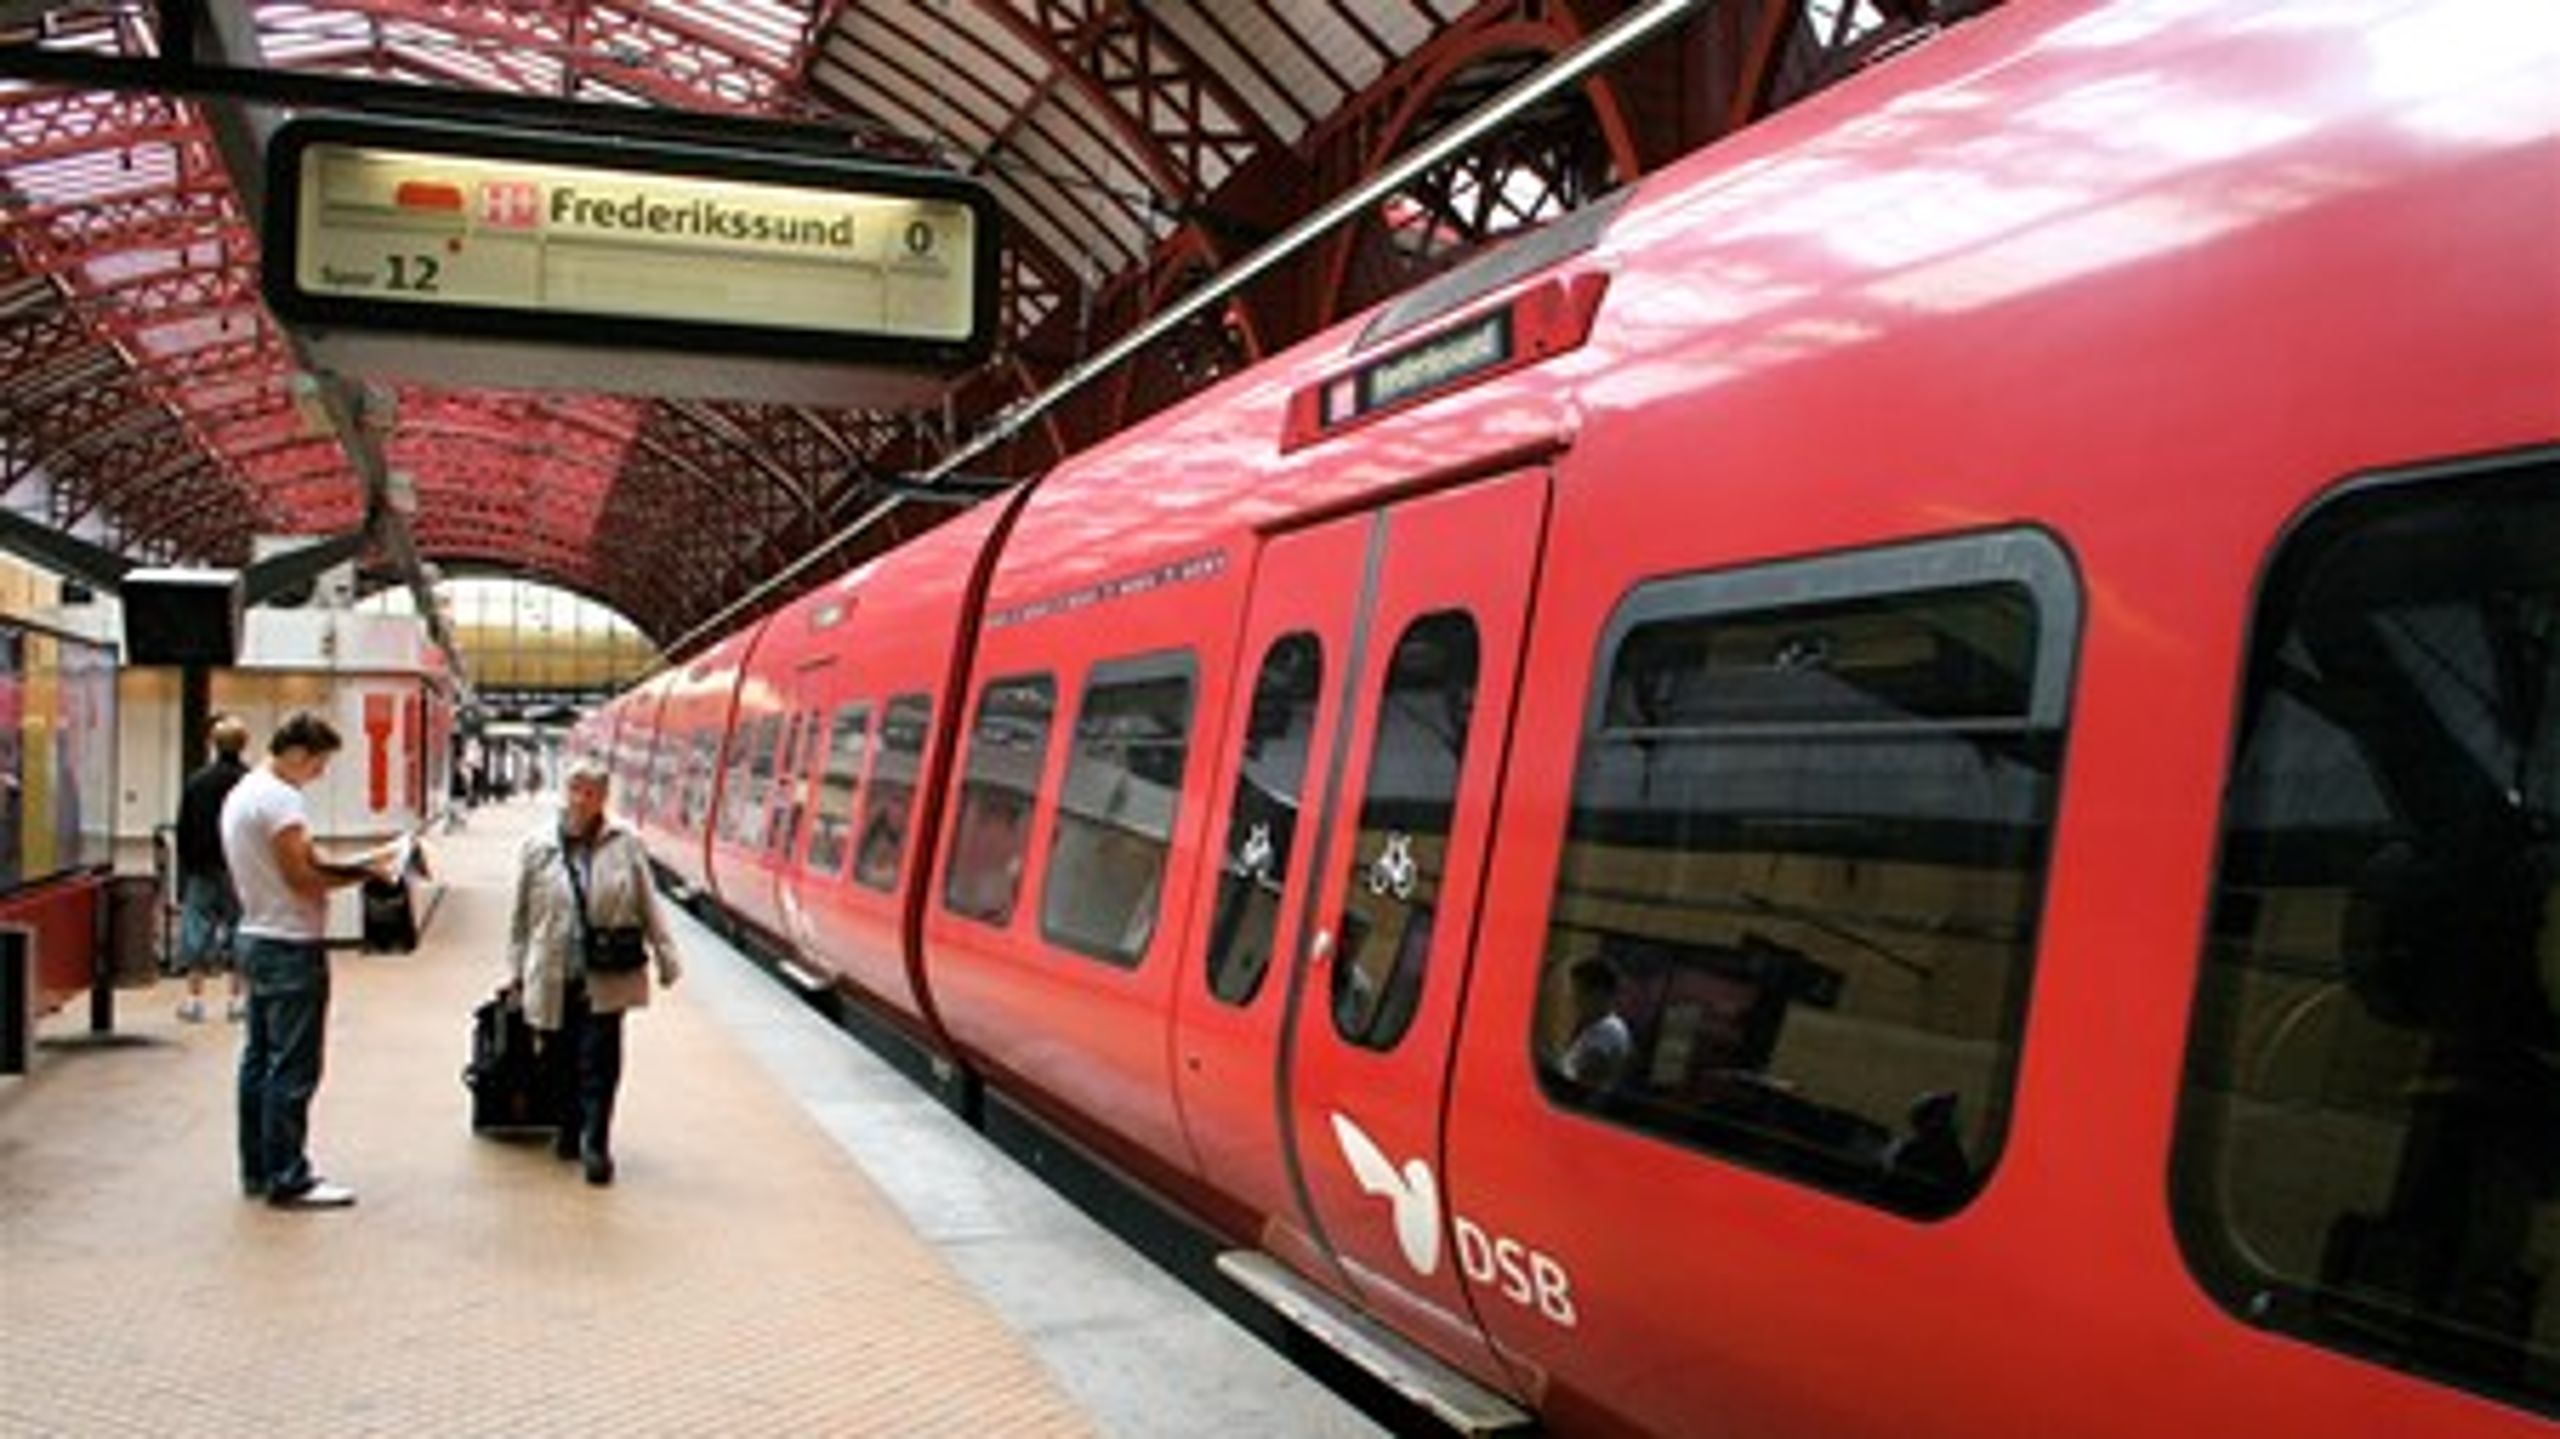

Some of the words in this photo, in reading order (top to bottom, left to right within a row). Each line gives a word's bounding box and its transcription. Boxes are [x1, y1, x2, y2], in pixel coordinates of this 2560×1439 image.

[550, 186, 854, 248] Frederikssund
[386, 254, 439, 290] 12
[1454, 1214, 1577, 1327] DSB
